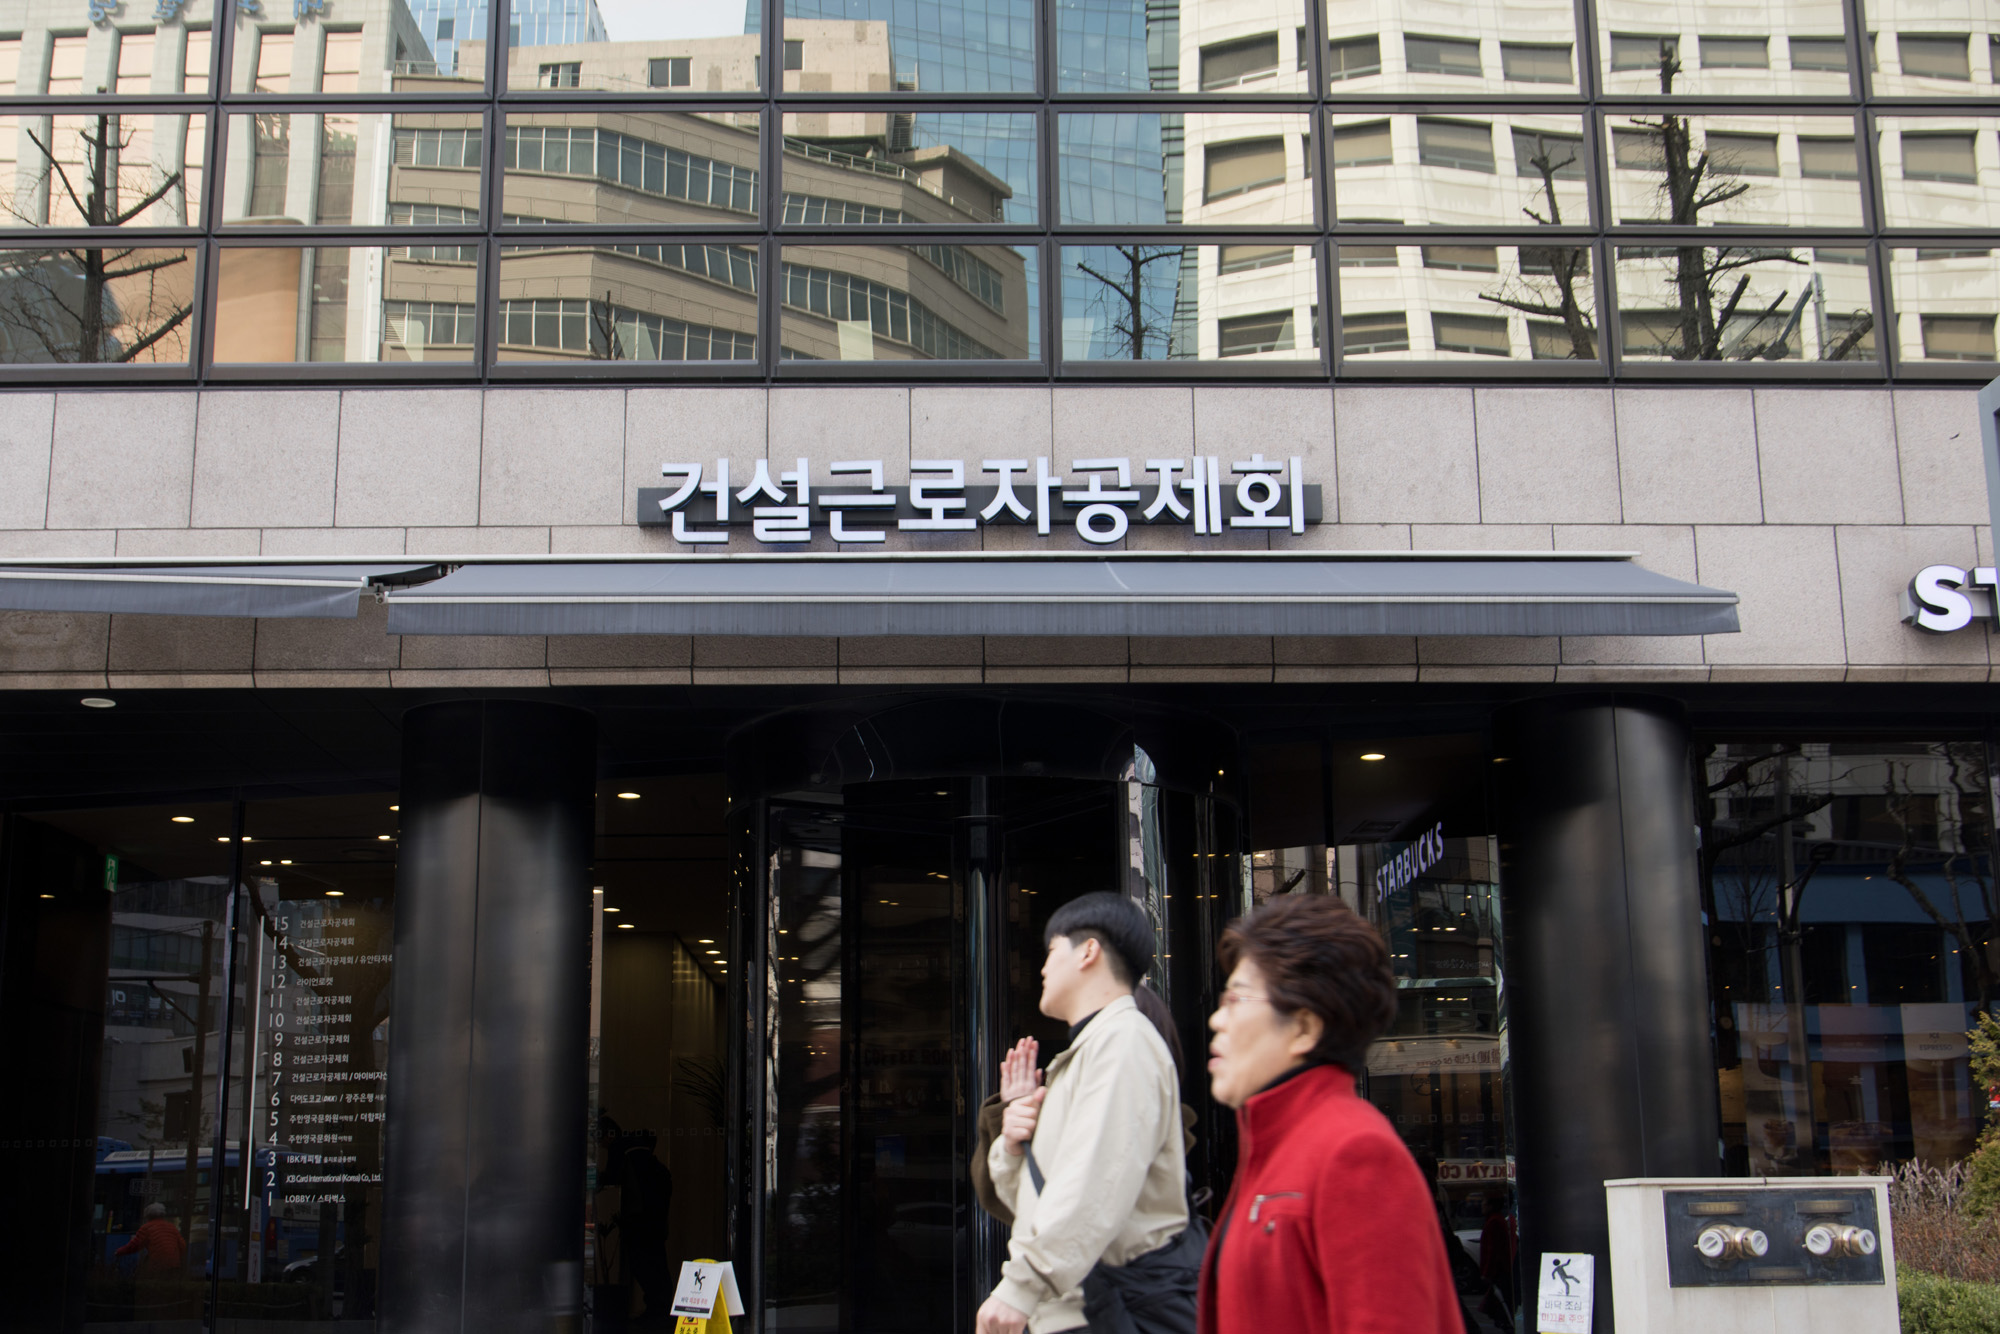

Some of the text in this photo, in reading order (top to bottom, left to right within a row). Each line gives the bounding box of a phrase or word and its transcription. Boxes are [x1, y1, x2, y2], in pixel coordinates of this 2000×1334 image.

[657, 453, 1306, 545] 건설근로자공제회
[1376, 821, 1444, 904] STARBUCKS
[274, 916, 355, 931] 15 건설근로자공제회
[273, 935, 355, 950] 14 건설근로자공제회
[272, 955, 287, 970] 13
[298, 956, 354, 967] 건설근로자공제회
[271, 974, 334, 989] 12 라이언로켓
[270, 994, 352, 1009] 11 건설근로자공제회
[269, 1012, 352, 1028] 10 건설근로자공제회
[274, 1032, 350, 1047] 9 건설근로자공제회
[272, 1052, 349, 1067] 8 건설근로자공제회
[272, 1072, 282, 1086] 7
[292, 1072, 348, 1082] 건설근로자공제회
[271, 1092, 280, 1106] 6
[345, 1094, 374, 1104] 광주은행
[270, 1111, 279, 1126] 5
[268, 1131, 278, 1146] 4
[268, 1151, 277, 1166] 3
[286, 1154, 322, 1165] IBK캐피탈
[266, 1171, 276, 1187] 2
[296, 1174, 308, 1182] Card
[308, 1174, 342, 1182] International
[268, 1191, 272, 1207] 1
[284, 1194, 311, 1203] LOBBY
[317, 1194, 346, 1204] 스타벅스
[1544, 1300, 1582, 1311] 바닥 조심
[1541, 1312, 1585, 1324] 미끄럼 주의
